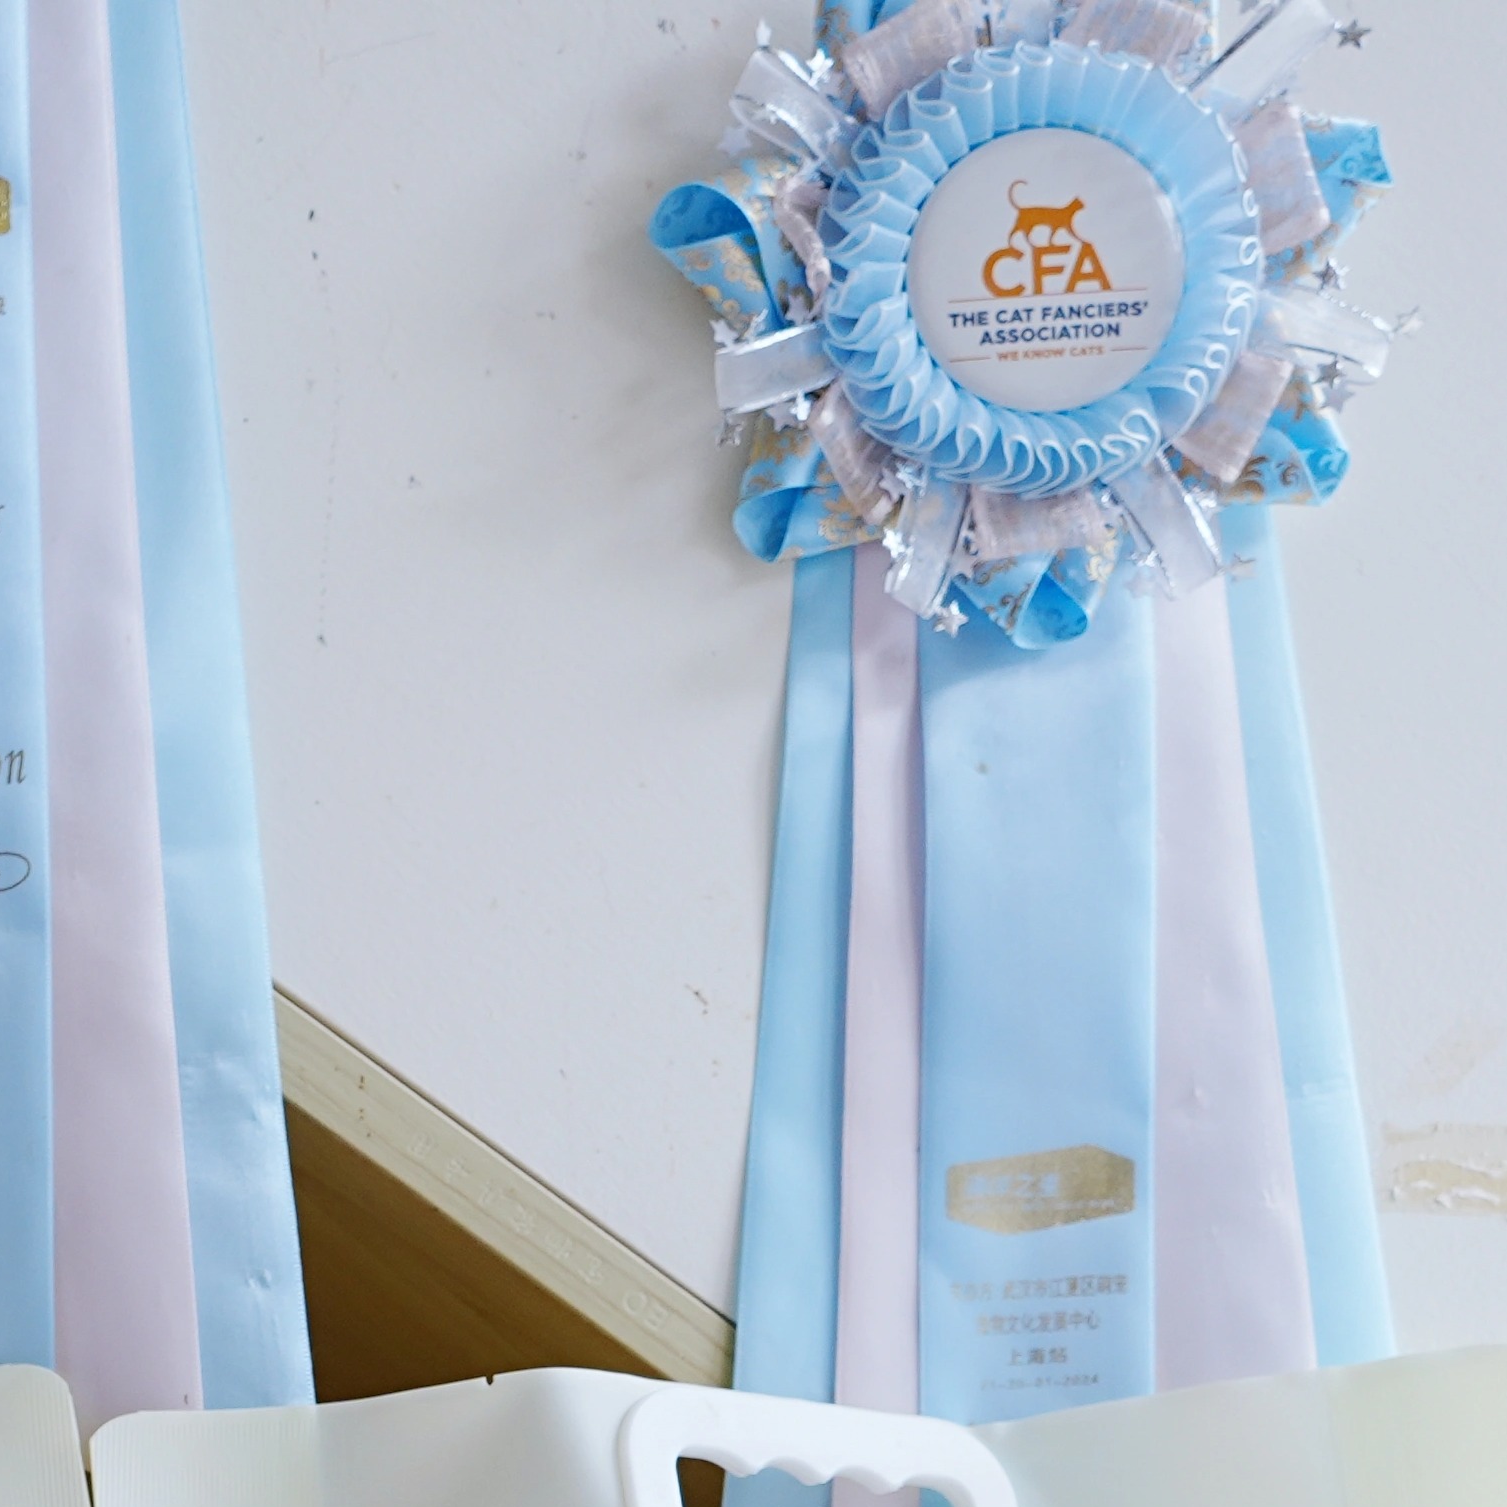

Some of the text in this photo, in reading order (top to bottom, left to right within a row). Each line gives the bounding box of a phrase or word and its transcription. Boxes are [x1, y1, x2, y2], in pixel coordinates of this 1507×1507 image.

[981, 241, 1114, 298] CFA
[948, 311, 989, 328] THE
[995, 308, 1034, 324] CAT
[979, 323, 1121, 345] ASSOCIATION
[997, 345, 1105, 363] WE KNOW CATS
